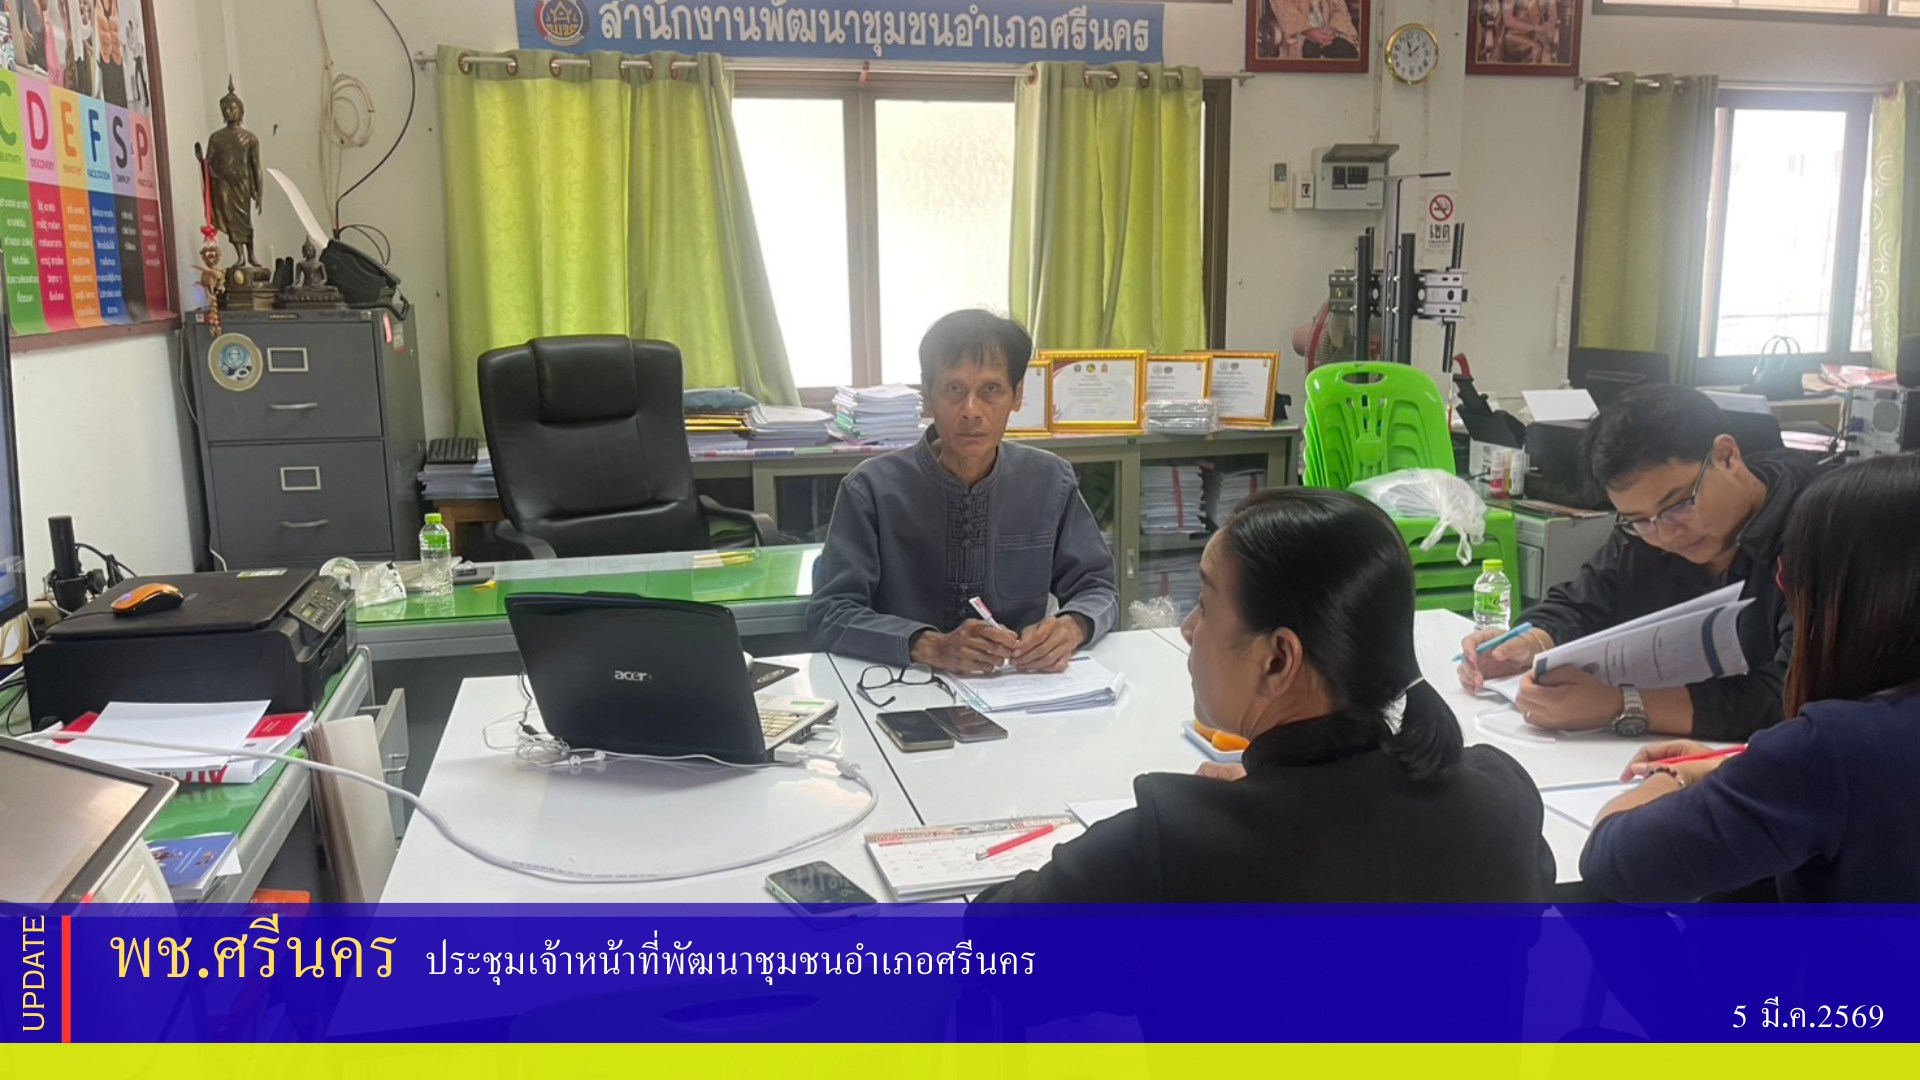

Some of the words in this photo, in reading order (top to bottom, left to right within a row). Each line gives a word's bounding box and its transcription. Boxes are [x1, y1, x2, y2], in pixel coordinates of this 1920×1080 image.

[599, 0, 1149, 57] สำนักงานพัฒนาชุมชนอำเภอศรีนคร
[26, 90, 49, 150] D
[60, 101, 77, 157] E
[88, 109, 102, 163] F
[112, 115, 128, 169] S
[135, 123, 148, 172] P
[614, 670, 648, 681] acer
